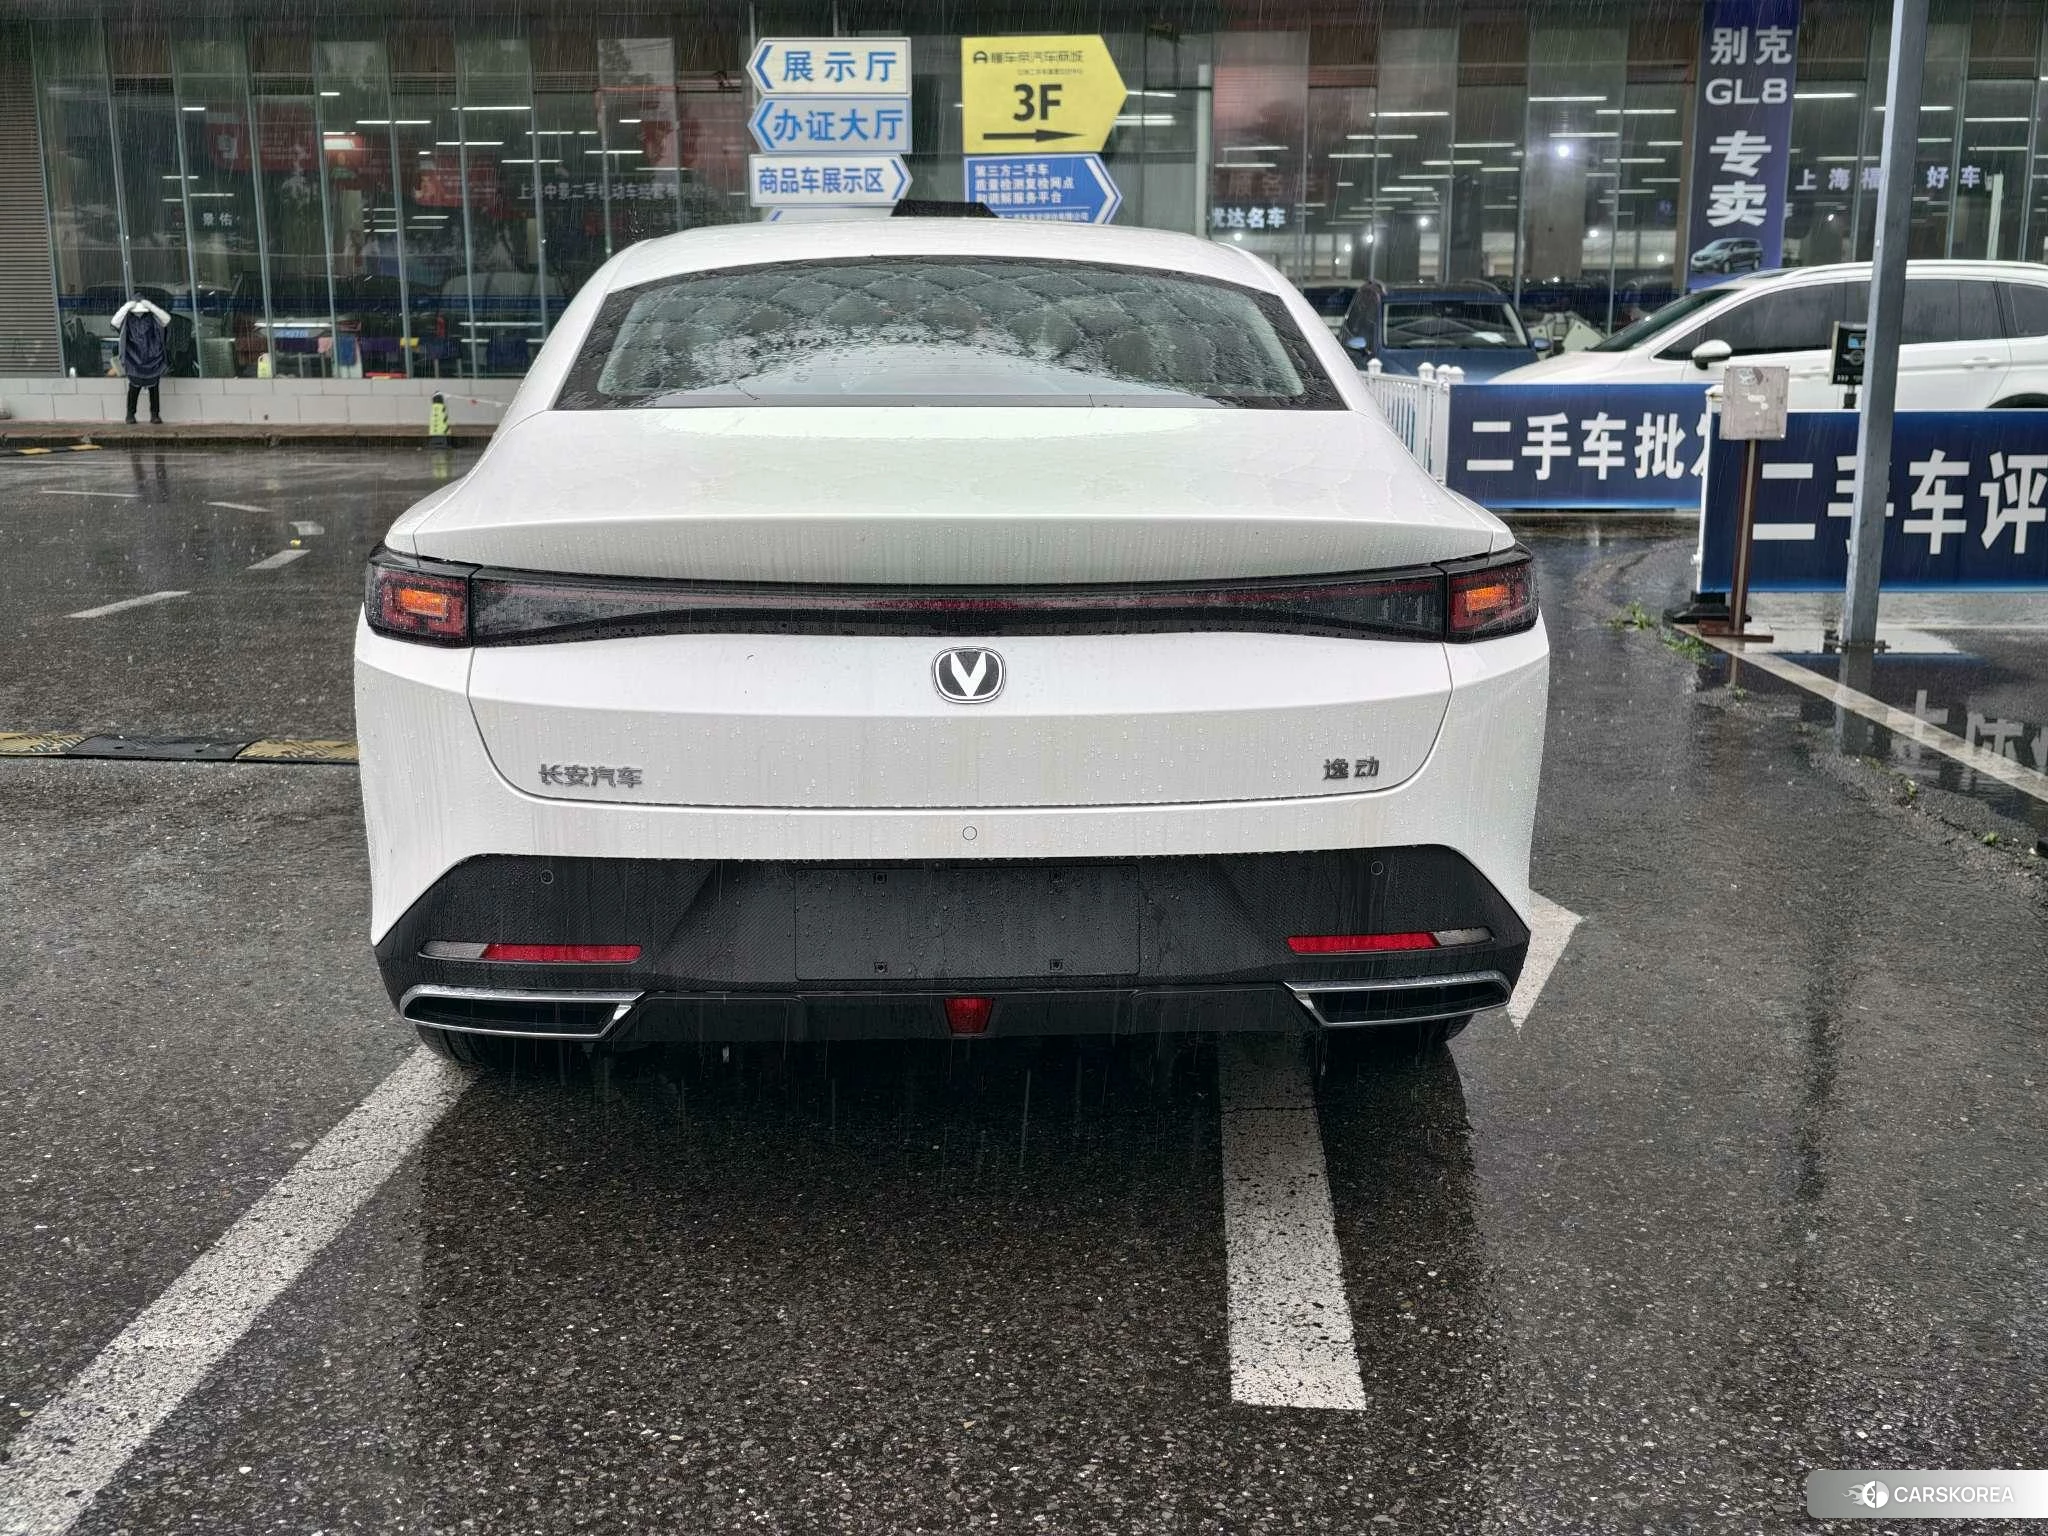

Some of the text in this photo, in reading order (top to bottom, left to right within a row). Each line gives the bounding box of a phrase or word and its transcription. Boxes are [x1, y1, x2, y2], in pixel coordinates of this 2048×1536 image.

[1710, 25, 1794, 65] 别克
[783, 50, 896, 82] 展示厅
[1013, 83, 1063, 122] 3F
[1705, 78, 1789, 105] GL8
[773, 108, 903, 141] 办证大厅
[758, 166, 884, 194] 商品车展示区
[1706, 130, 1772, 227] 专卖
[1466, 412, 1707, 481] 二手车批
[539, 763, 643, 788] 长安汽车
[1323, 756, 1380, 780] 逸动
